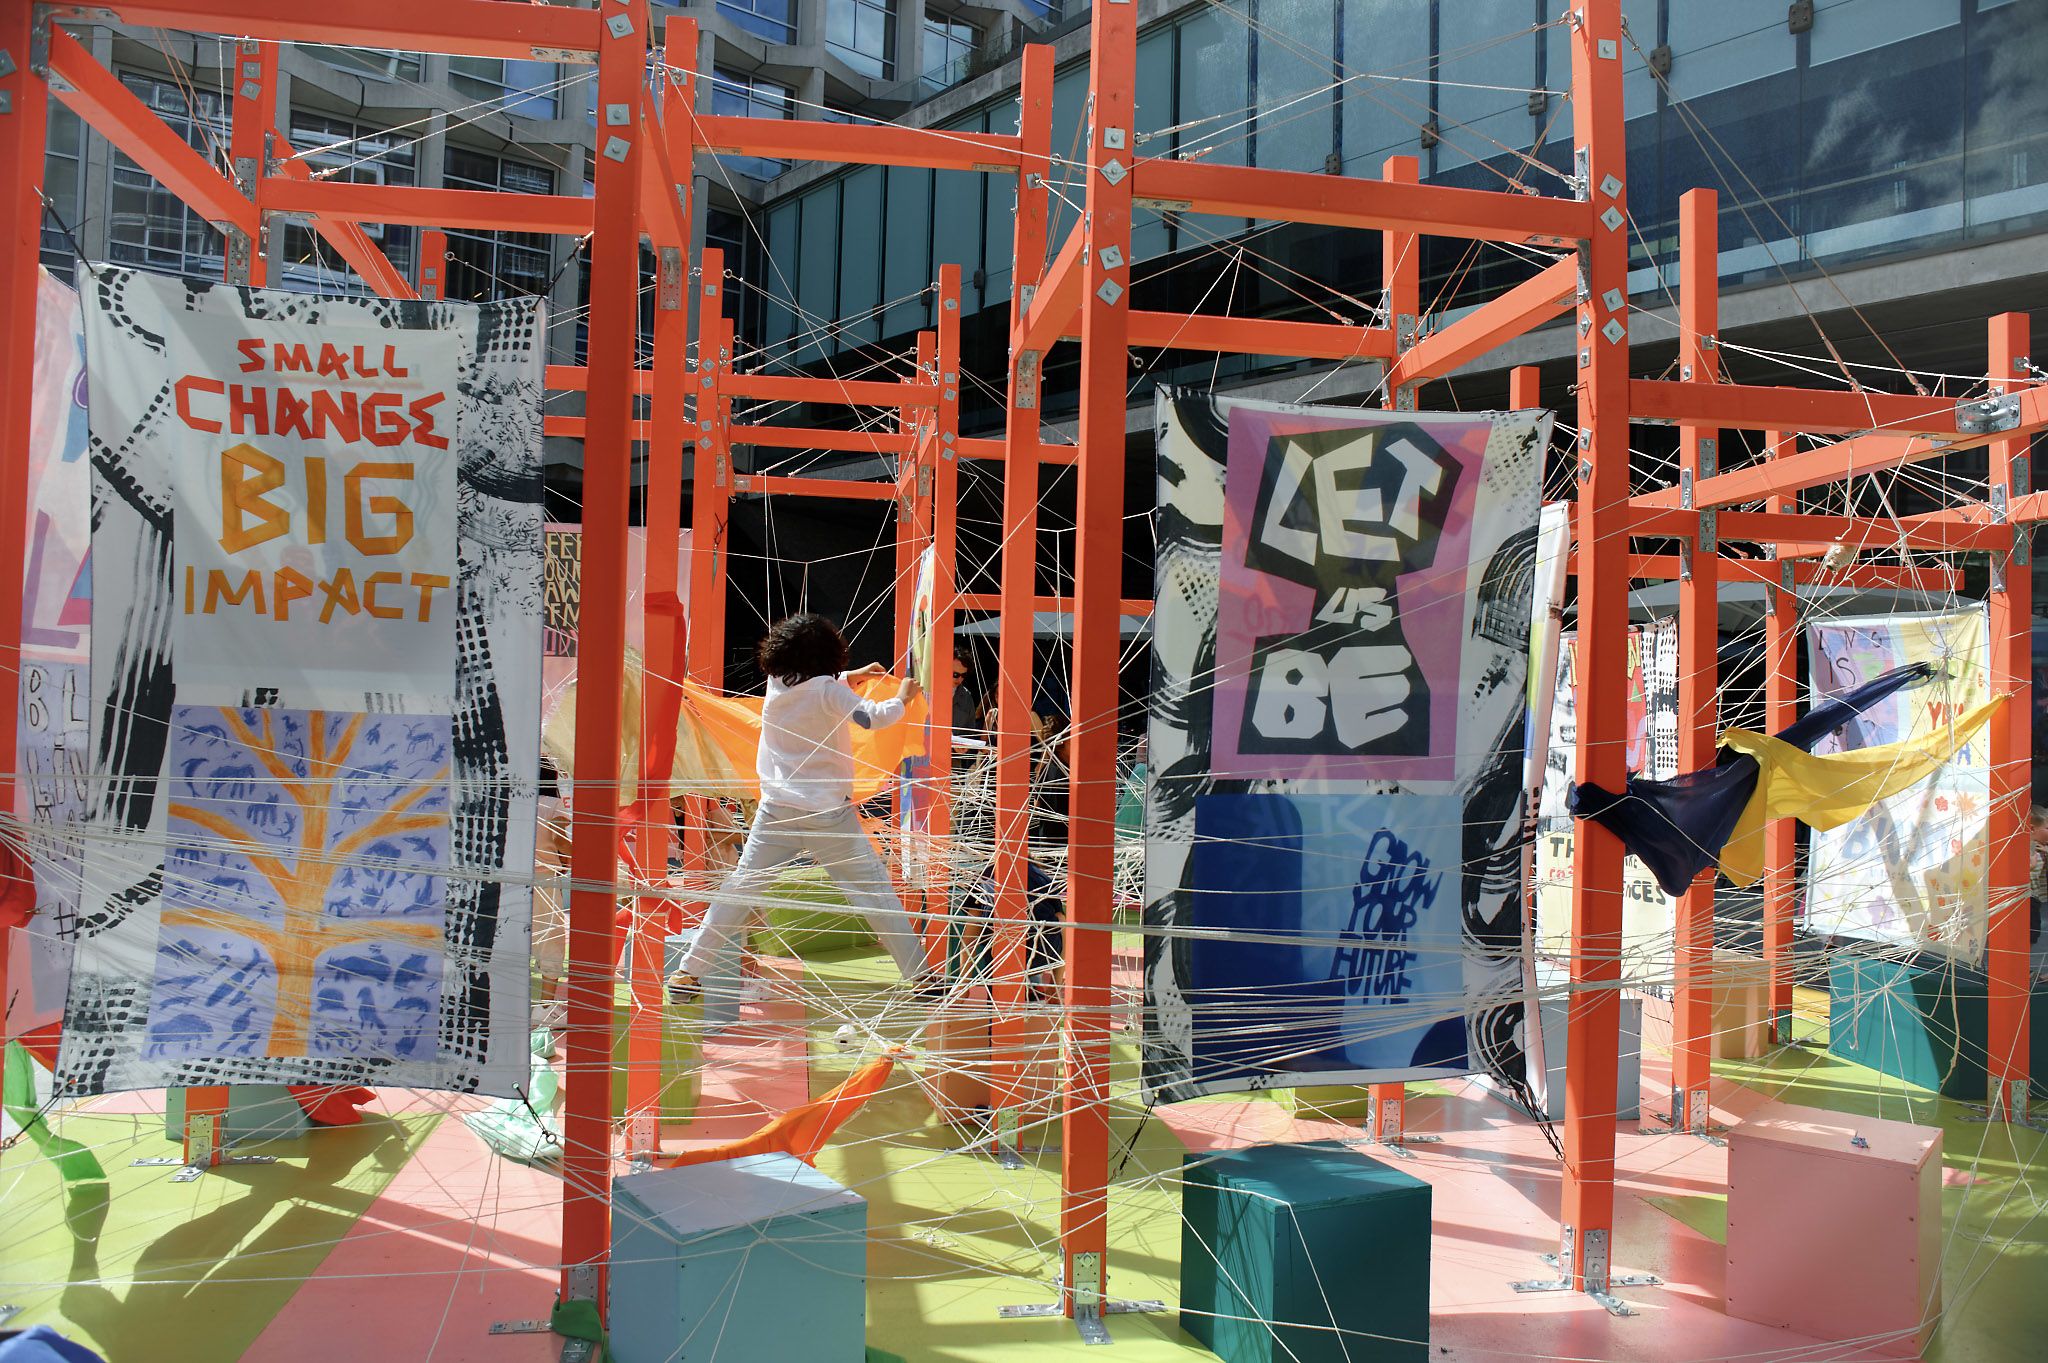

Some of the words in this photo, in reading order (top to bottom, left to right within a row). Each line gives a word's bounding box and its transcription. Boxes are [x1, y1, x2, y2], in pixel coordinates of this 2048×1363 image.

[238, 338, 408, 381] SMALL
[174, 374, 450, 450] CHANGE
[219, 442, 415, 556] BIG
[1260, 432, 1443, 567] LET
[185, 565, 451, 625] IMPACT
[1315, 587, 1393, 632] US
[22, 663, 90, 735] BL
[1252, 644, 1412, 750] BE
[1329, 929, 1418, 1005] FUTURE
